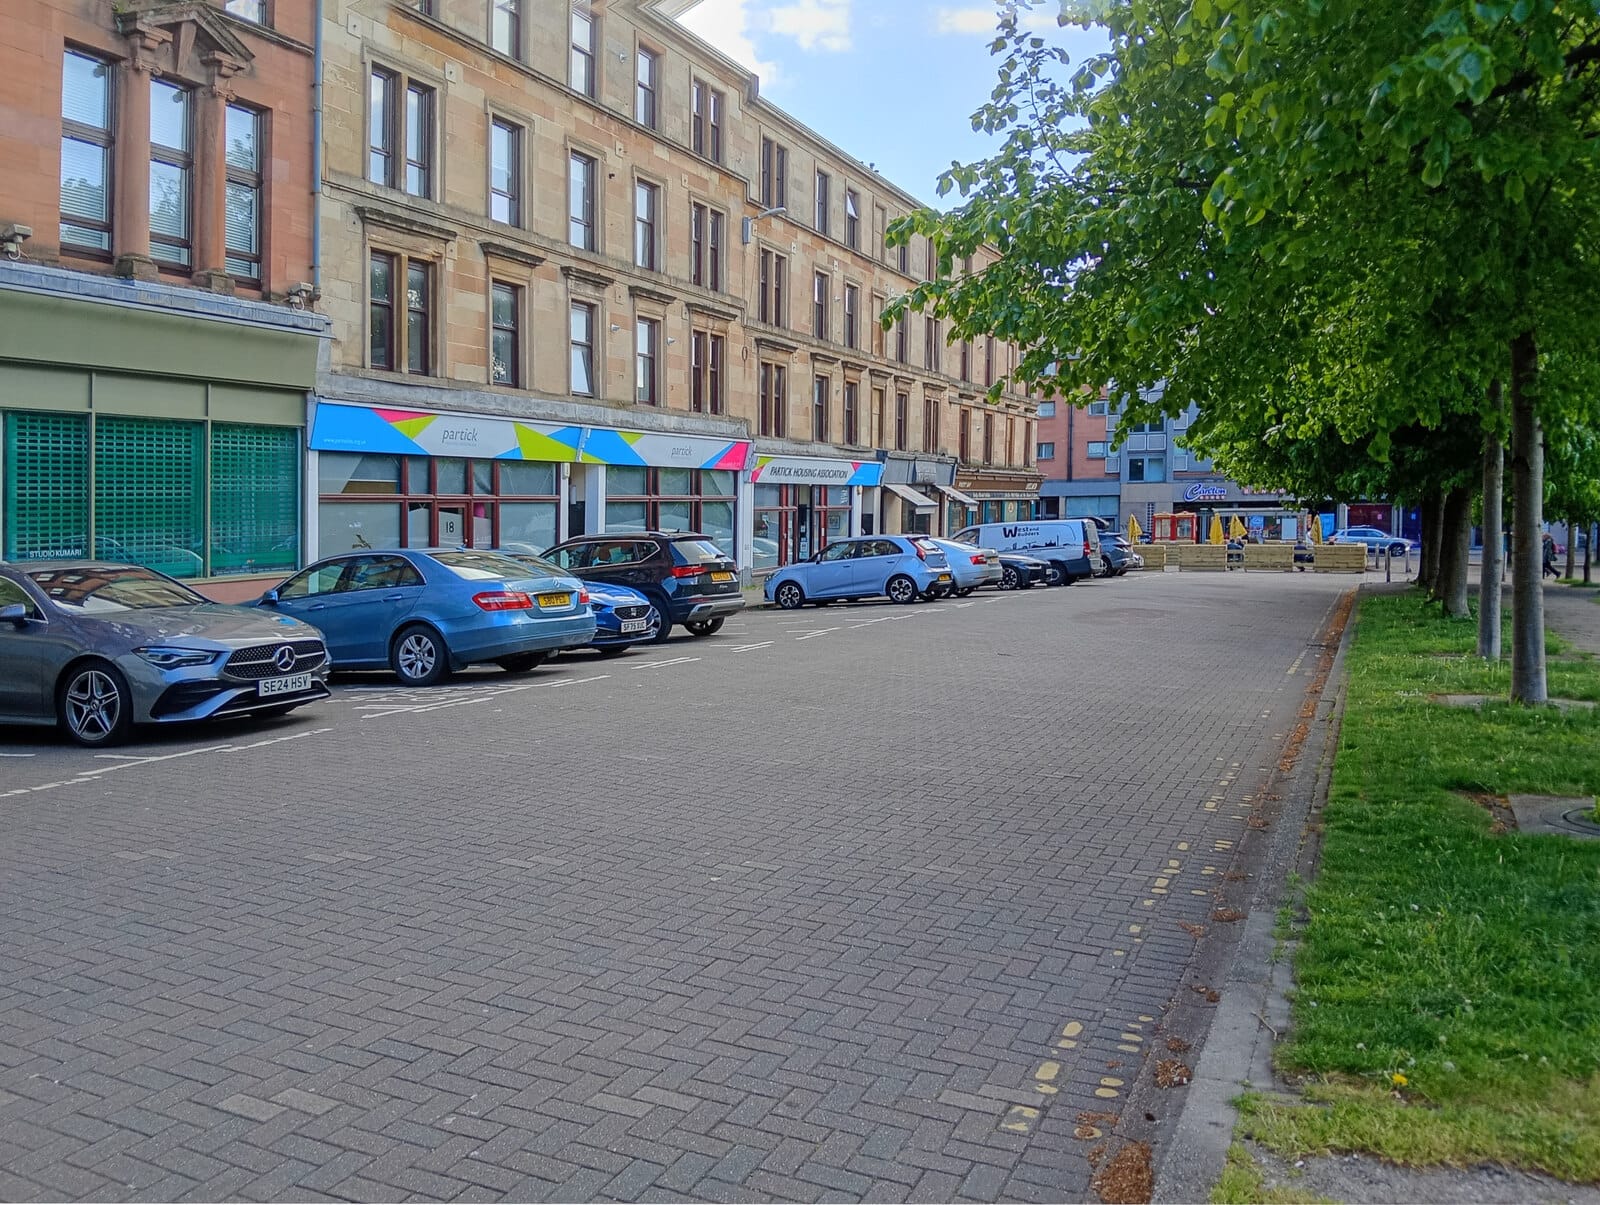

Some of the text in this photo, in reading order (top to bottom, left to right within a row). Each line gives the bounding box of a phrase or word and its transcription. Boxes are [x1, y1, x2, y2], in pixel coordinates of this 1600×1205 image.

[441, 428, 478, 444] partick
[769, 466, 849, 479] PARTICK HOUSING ASSOCIATION
[1184, 483, 1227, 502] Carlton
[446, 521, 455, 533] 18
[29, 549, 82, 558] STUDIO KUMARI
[263, 675, 308, 693] SE24 HSV
